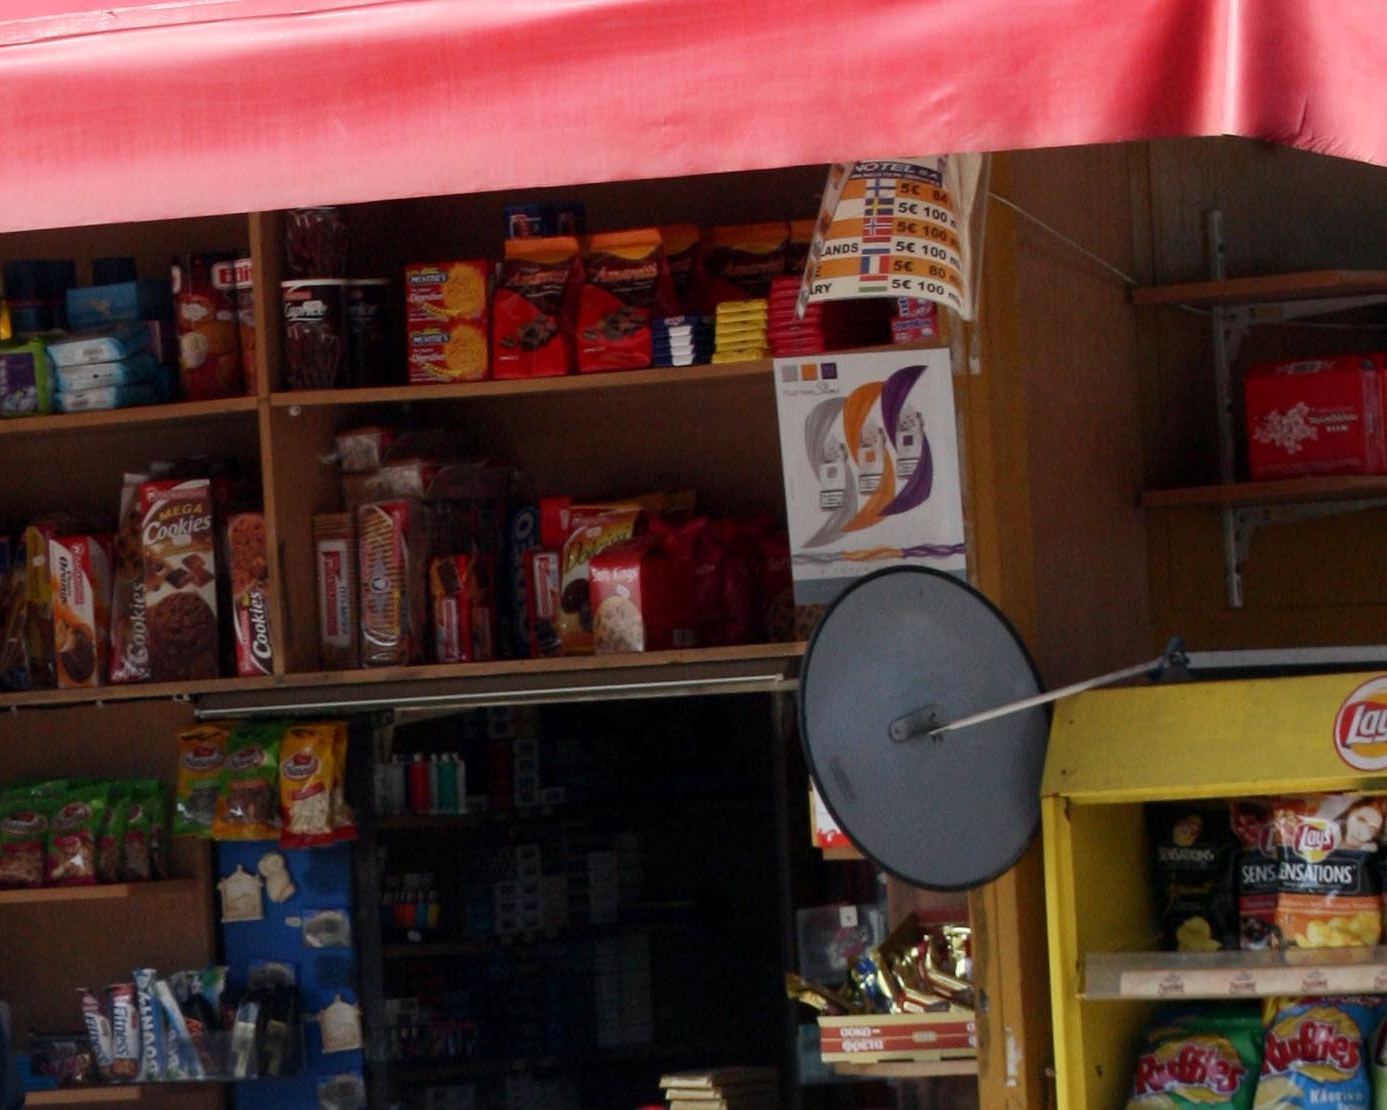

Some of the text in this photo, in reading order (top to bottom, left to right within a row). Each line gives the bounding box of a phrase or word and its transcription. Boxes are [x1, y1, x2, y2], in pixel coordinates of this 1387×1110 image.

[898, 202, 948, 222] 5€ 100
[896, 221, 947, 242] 5€ 100
[895, 241, 916, 254] 5€
[921, 244, 947, 260] 100
[893, 260, 946, 279] 5€ 80
[808, 279, 944, 296] ARY 5€ 100
[159, 503, 204, 521] MEGA
[143, 514, 213, 546] Cookies
[251, 590, 273, 660] Cookies
[1345, 703, 1387, 747] Lay
[1241, 863, 1278, 884] SENS
[1261, 1014, 1362, 1075] Ruffles
[1134, 1040, 1248, 1097] Ruffles
